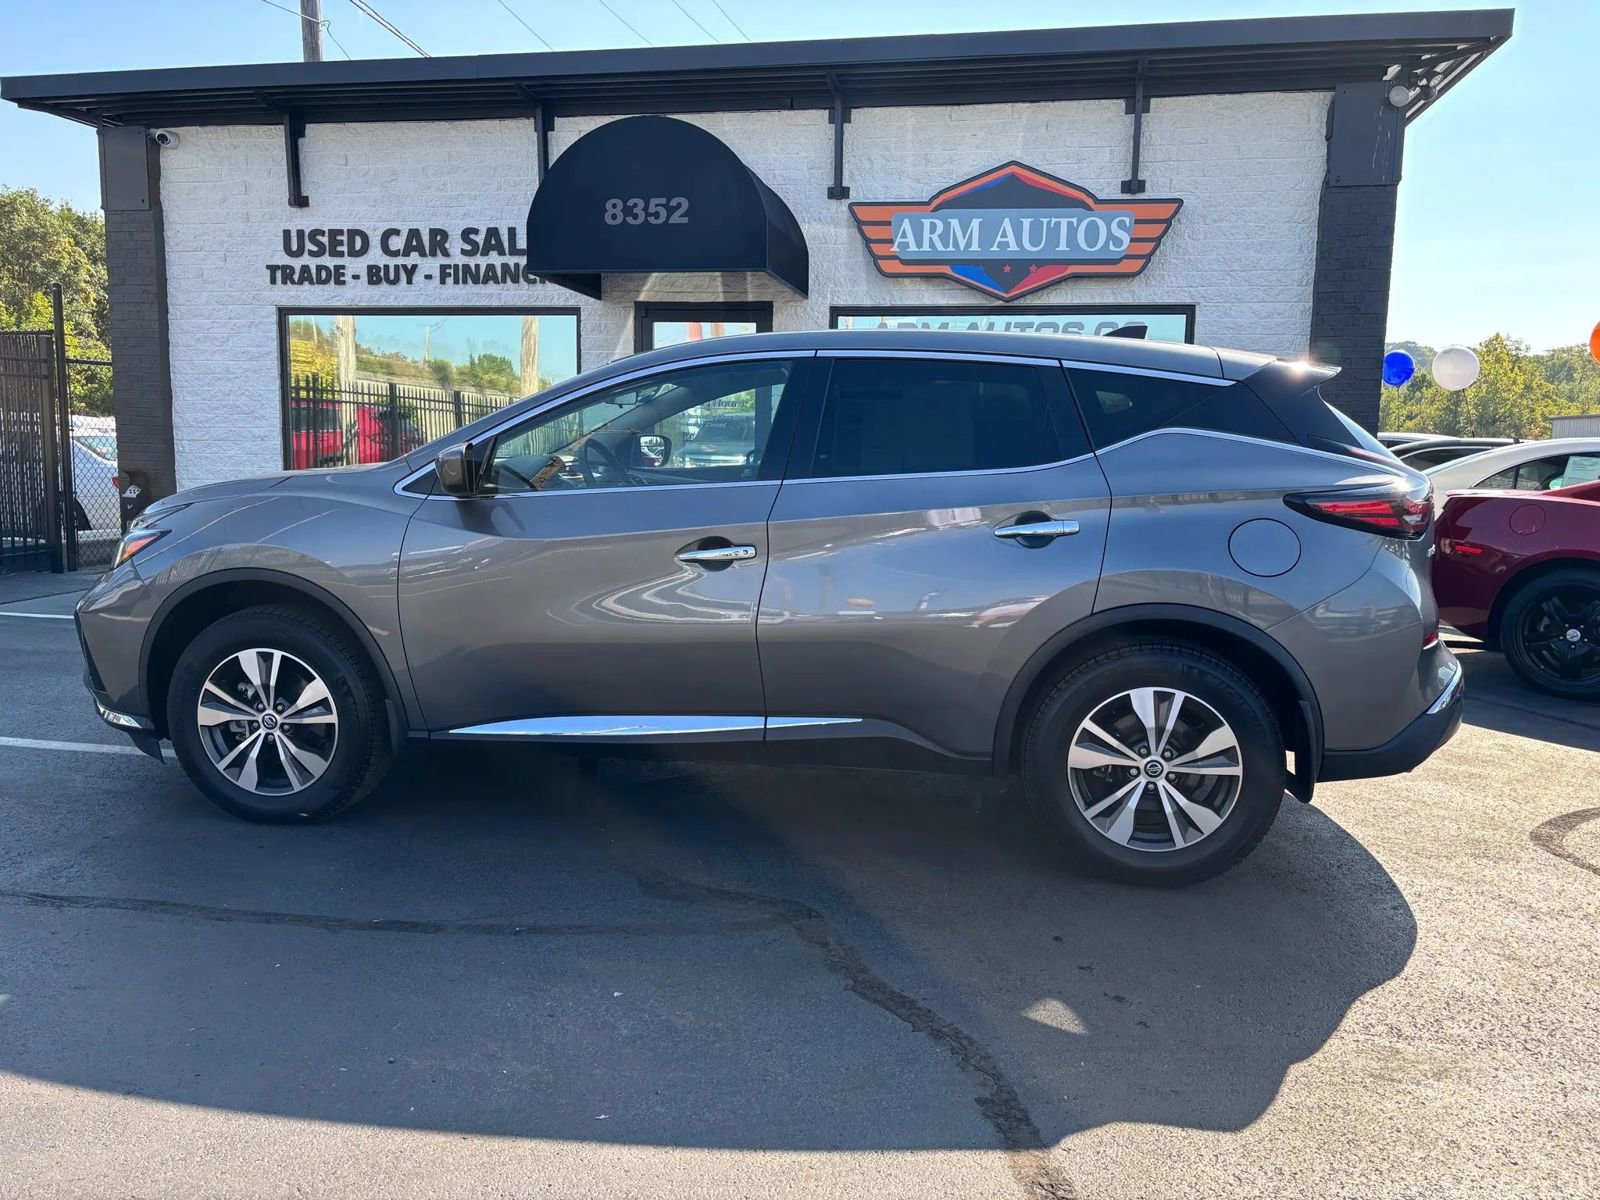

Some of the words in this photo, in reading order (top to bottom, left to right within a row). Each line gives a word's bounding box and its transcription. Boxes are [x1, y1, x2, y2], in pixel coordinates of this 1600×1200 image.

[604, 196, 689, 226] 8352
[282, 228, 370, 258] USED
[380, 227, 451, 258] CAR
[890, 217, 983, 252] ARM
[990, 216, 1131, 252] AUTOS
[265, 264, 347, 286] TRADE
[366, 263, 419, 286] BUY
[439, 262, 546, 286] FINANC
